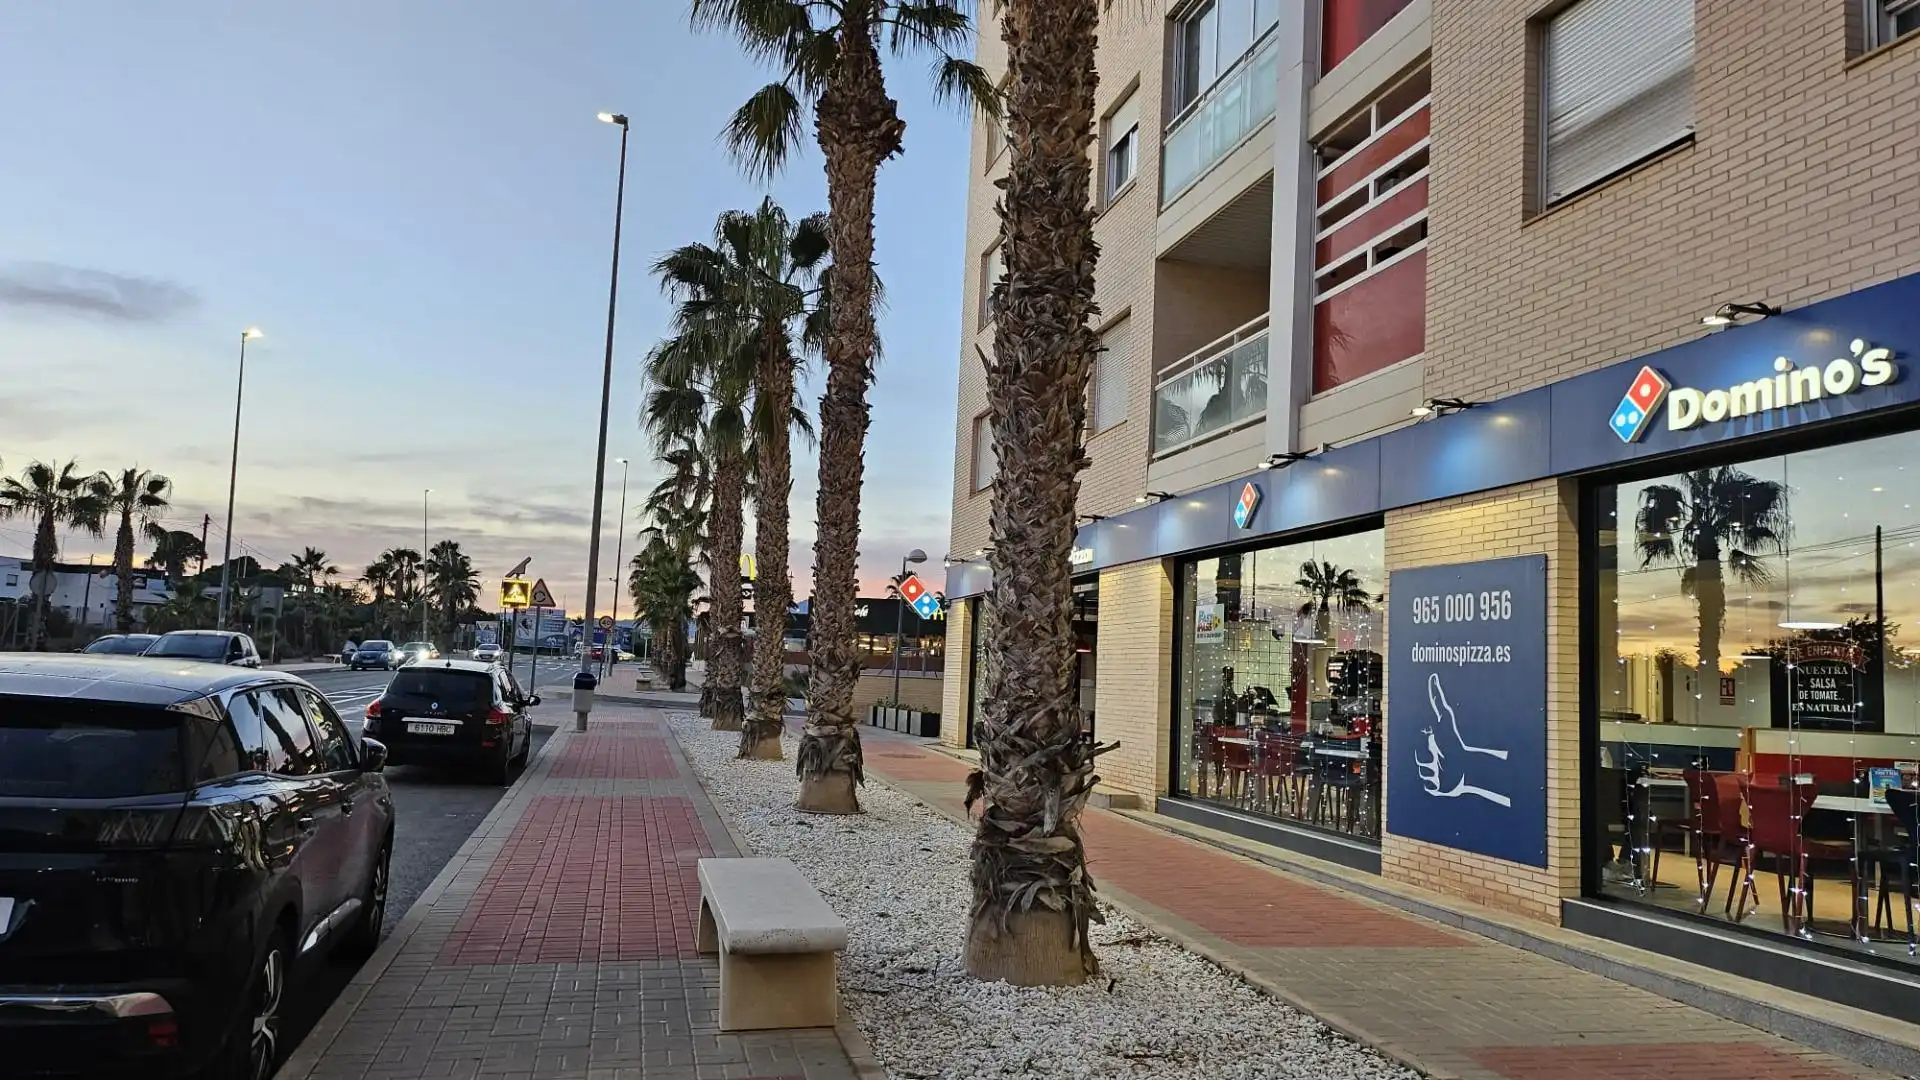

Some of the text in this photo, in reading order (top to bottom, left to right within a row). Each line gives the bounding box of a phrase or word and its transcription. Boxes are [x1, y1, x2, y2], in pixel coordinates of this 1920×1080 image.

[1667, 337, 1897, 431] Domino's
[1412, 589, 1512, 624] 965 000 956
[1411, 640, 1511, 667] dominospizza.es
[1798, 665, 1849, 675] NUESTRA
[1810, 677, 1836, 689] SALSA
[1799, 690, 1809, 700] DE
